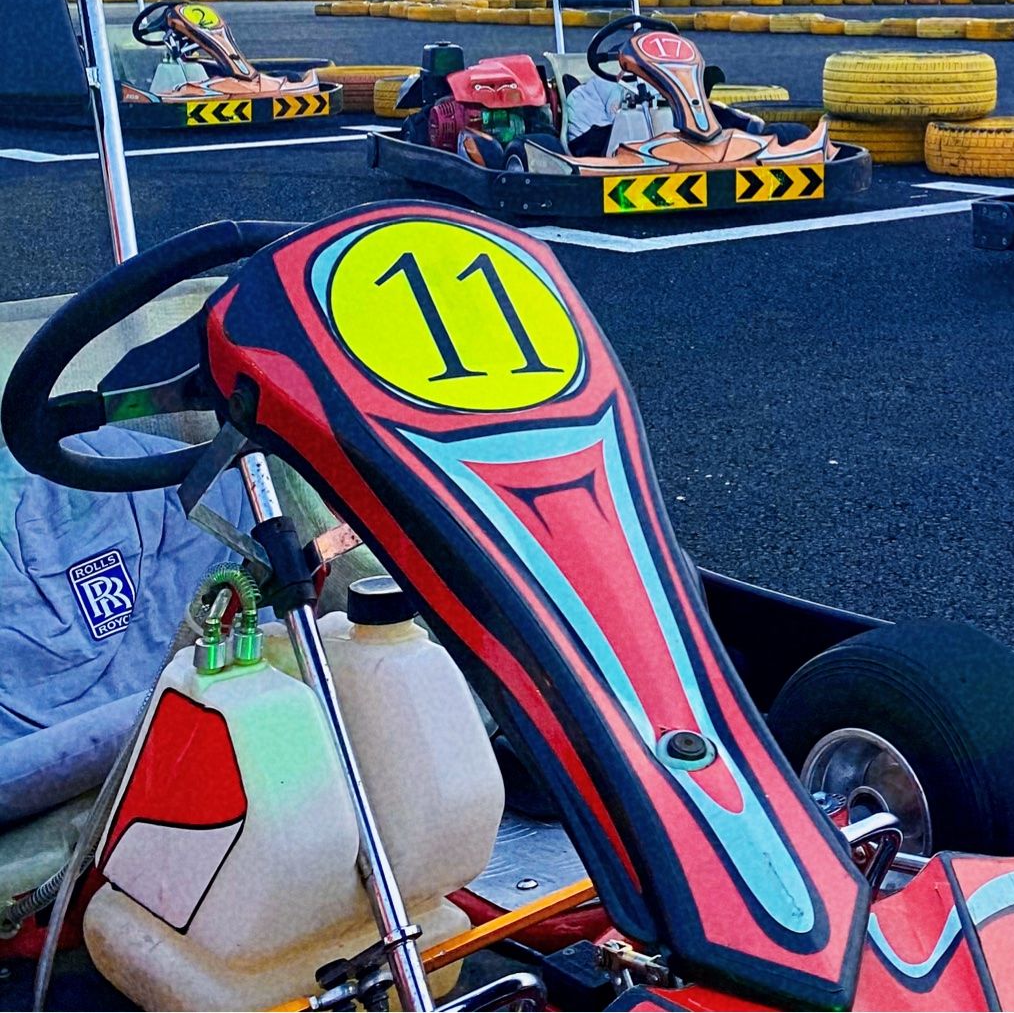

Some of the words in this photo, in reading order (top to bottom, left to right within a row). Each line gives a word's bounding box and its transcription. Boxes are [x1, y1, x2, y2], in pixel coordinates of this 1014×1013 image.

[192, 8, 213, 27] 2
[650, 37, 681, 57] 17
[374, 252, 564, 382] 11
[74, 555, 116, 578] ROLLS
[98, 614, 130, 634] ROYC
